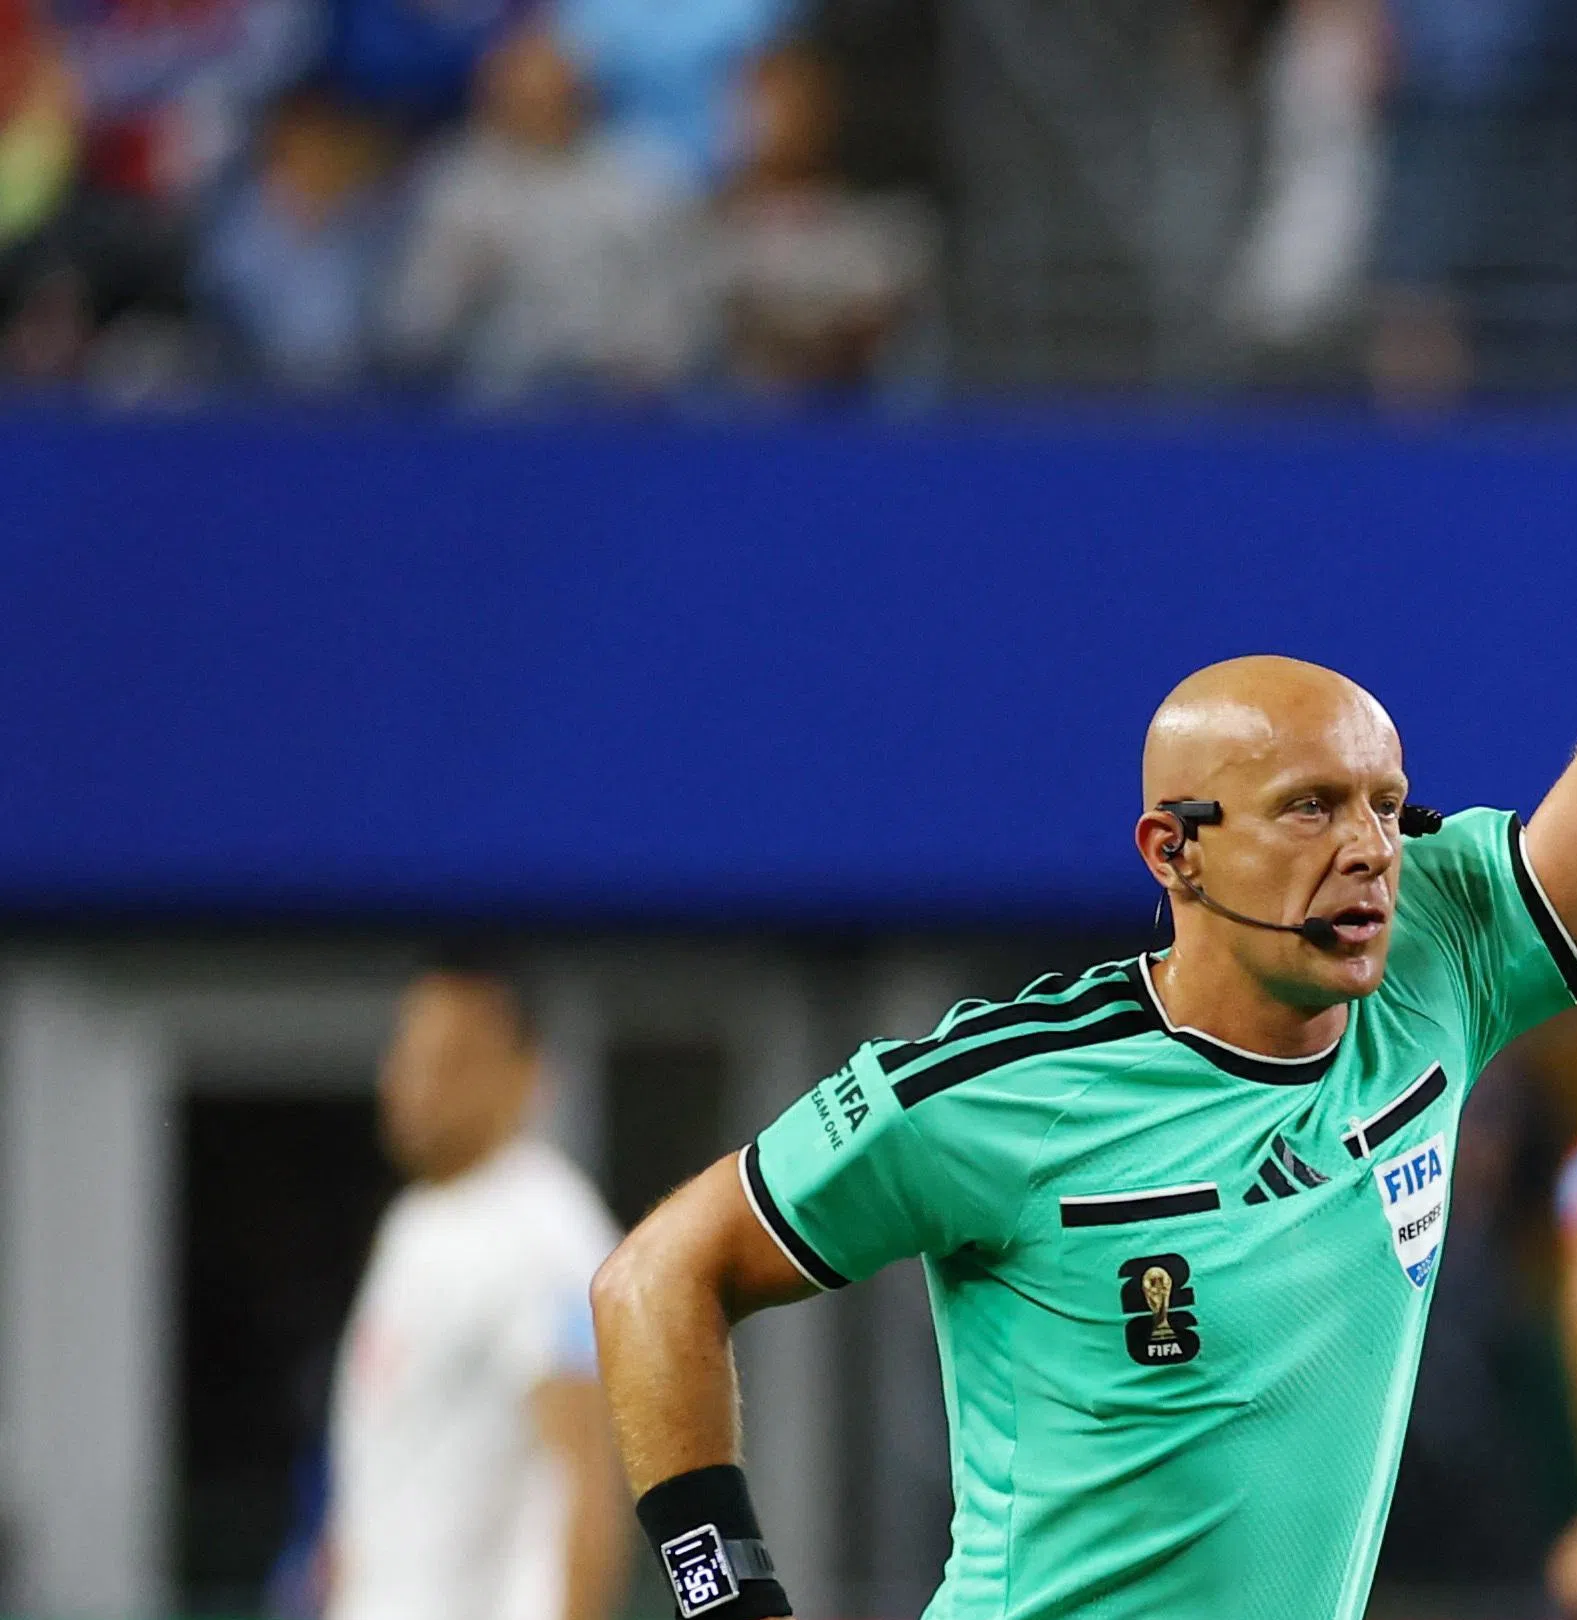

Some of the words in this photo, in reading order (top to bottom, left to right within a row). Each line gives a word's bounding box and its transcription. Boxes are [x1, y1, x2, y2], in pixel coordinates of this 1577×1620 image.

[811, 1087, 831, 1121] EAM
[824, 1120, 844, 1152] ONE
[1383, 1146, 1442, 1206] FIFA
[1147, 1342, 1183, 1357] FIFA
[674, 1540, 720, 1604] 11:56
